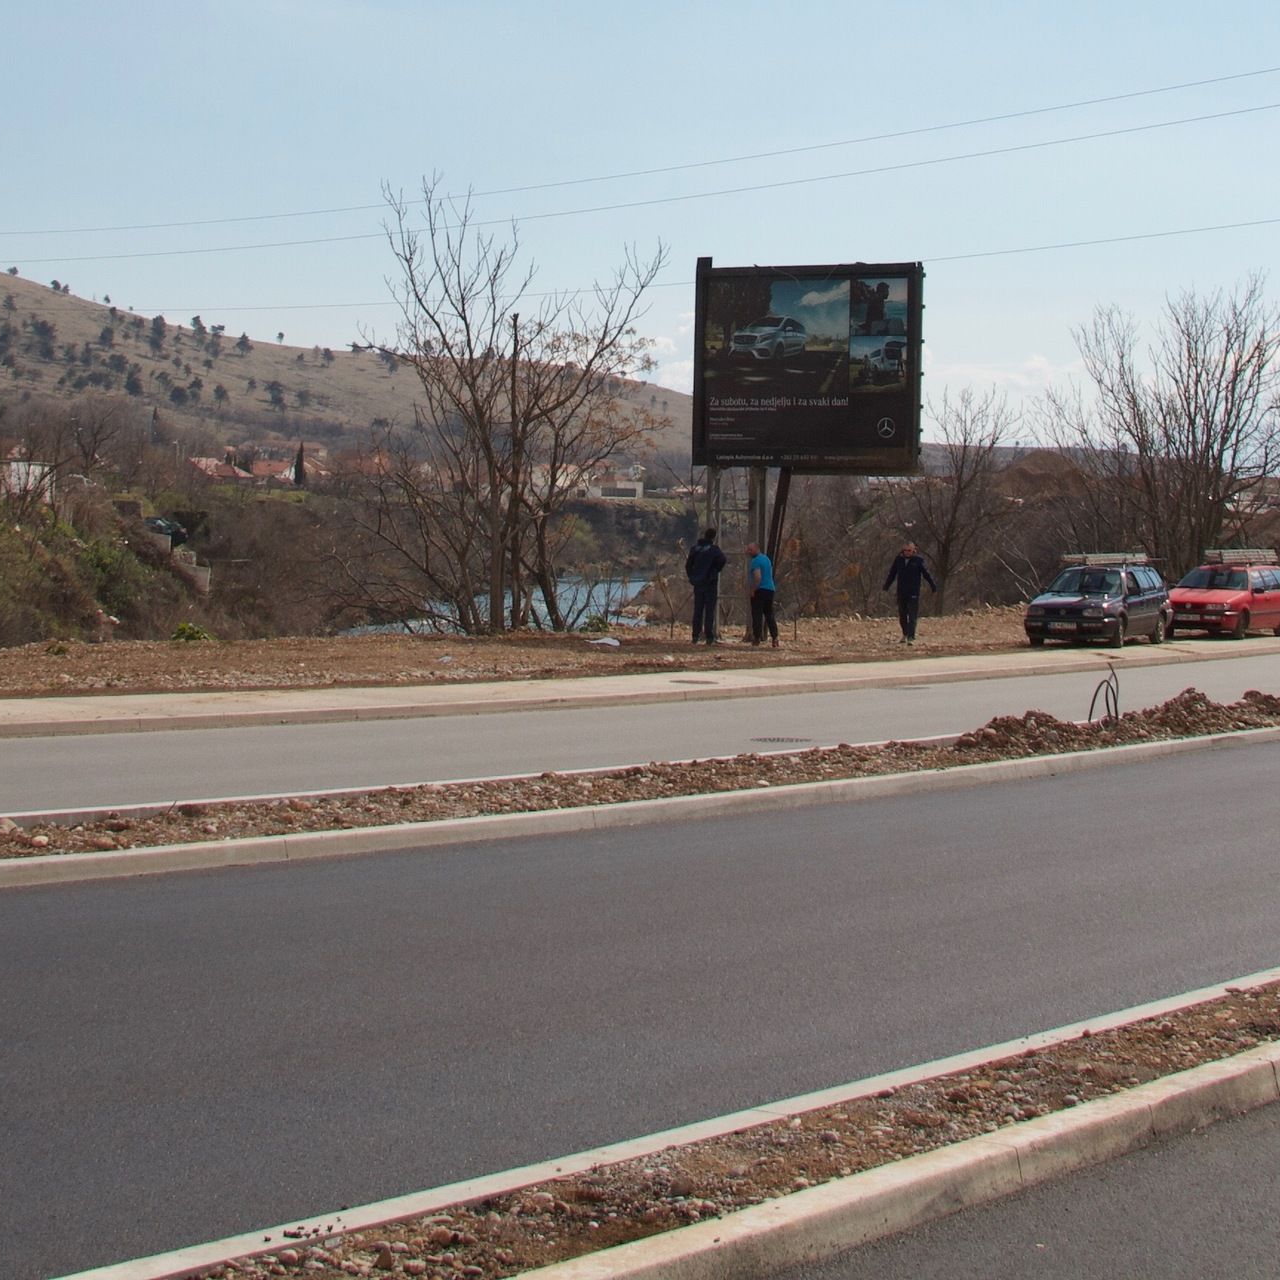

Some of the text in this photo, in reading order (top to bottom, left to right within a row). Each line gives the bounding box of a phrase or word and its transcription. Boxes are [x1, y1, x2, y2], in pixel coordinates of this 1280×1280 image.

[709, 396, 719, 406] Za
[720, 397, 749, 407] subotu,
[750, 398, 759, 406] za
[760, 396, 792, 408] nedjelju
[798, 398, 807, 406] za
[808, 396, 830, 406] svaki
[831, 396, 849, 406] dan!
